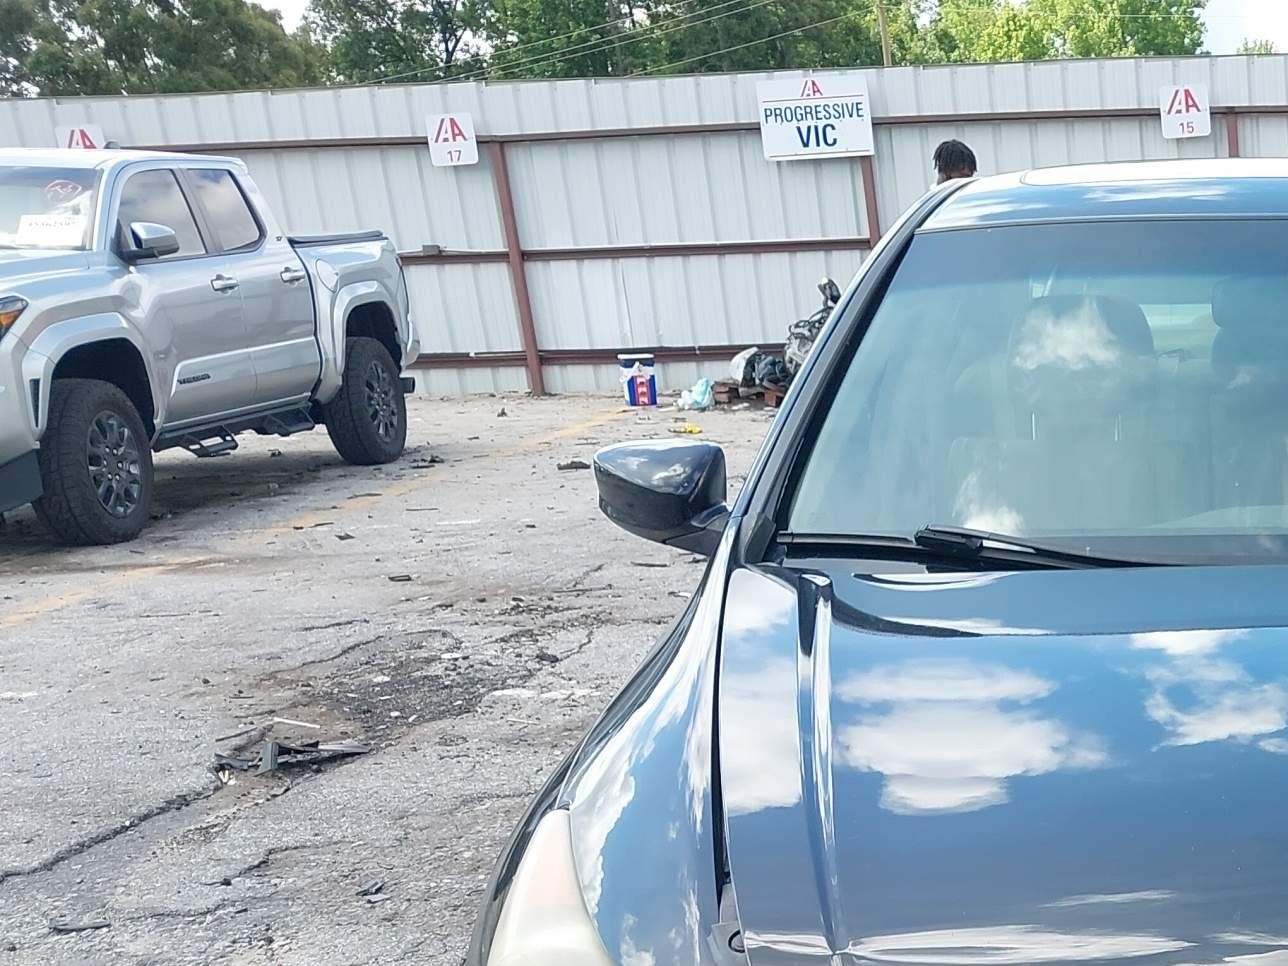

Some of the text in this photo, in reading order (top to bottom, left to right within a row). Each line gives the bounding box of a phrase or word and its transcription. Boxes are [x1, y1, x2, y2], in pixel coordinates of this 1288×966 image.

[763, 101, 865, 124] PROGRESSIVE
[796, 123, 838, 148] VIC
[1179, 121, 1194, 134] 15
[447, 149, 462, 162] 17
